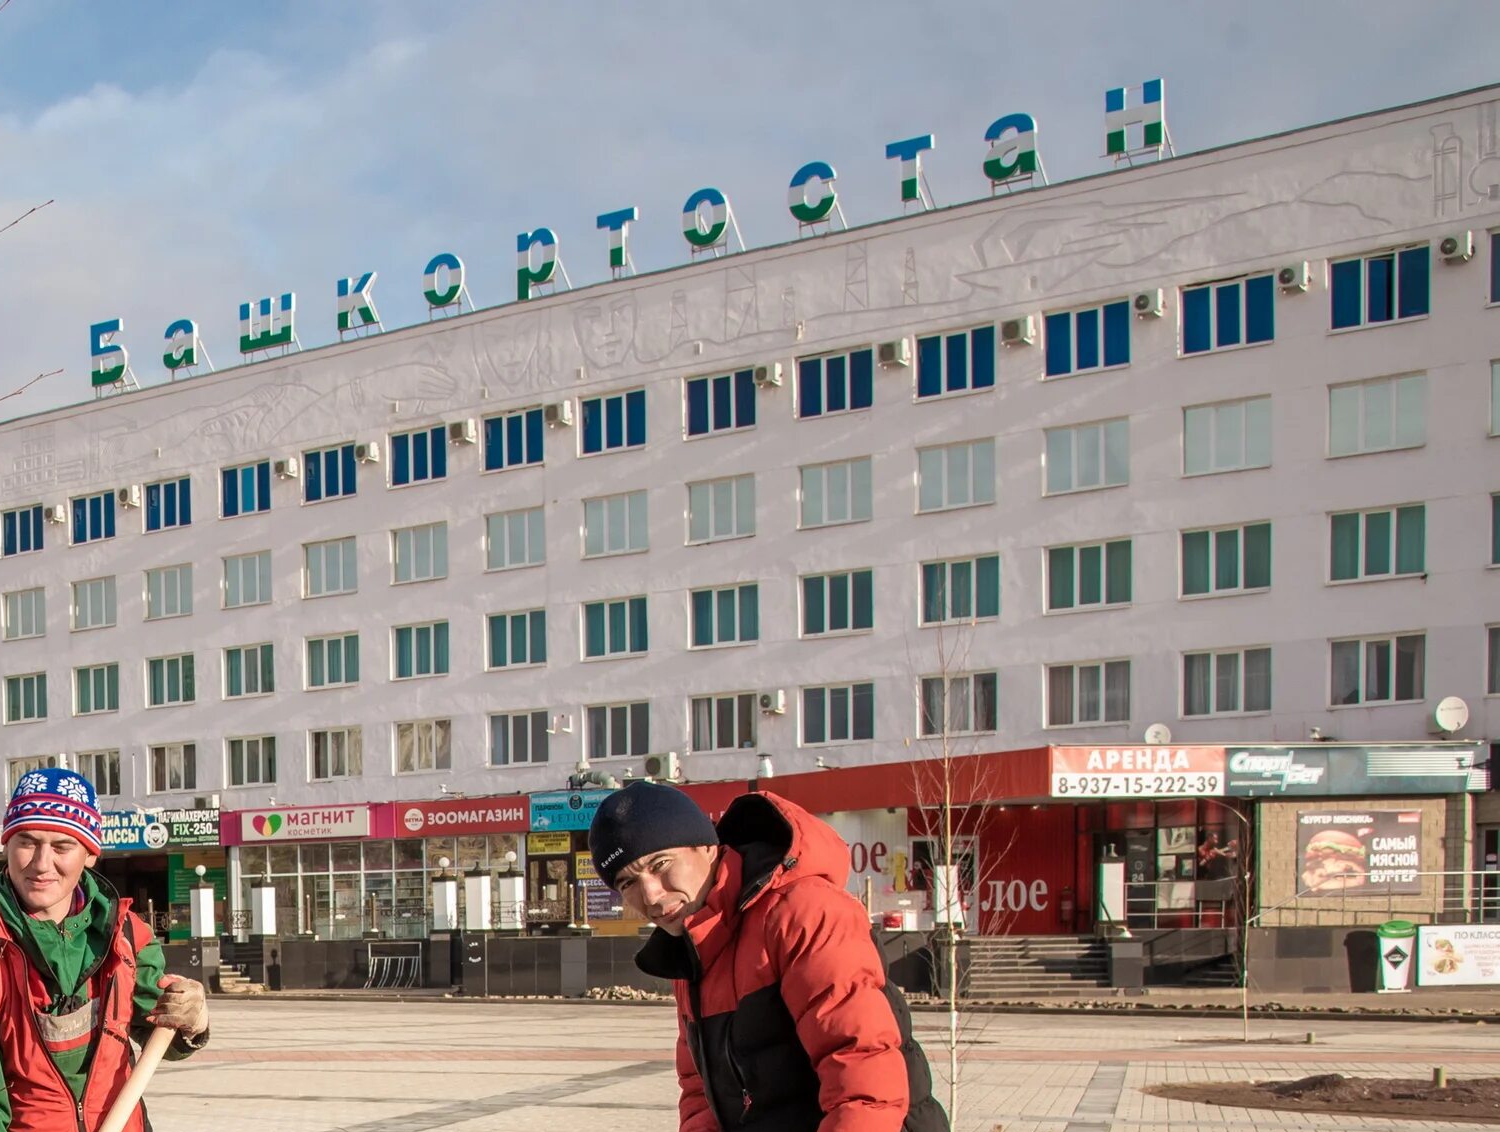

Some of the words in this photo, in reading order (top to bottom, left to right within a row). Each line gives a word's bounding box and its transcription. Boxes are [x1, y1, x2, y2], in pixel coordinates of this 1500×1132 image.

[1086, 749, 1191, 772] АРЕНДА
[1057, 775, 1218, 794] 8-937-15-222-39
[101, 814, 121, 828] ВИА
[130, 813, 147, 827] ЖД
[427, 807, 524, 825] ЗООМАГАЗИН
[173, 822, 213, 836] FIX-250
[287, 827, 332, 837] косметик
[1372, 835, 1417, 851] САМЫЙ
[1370, 852, 1419, 867] МЯСНОЙ
[1131, 873, 1145, 882] 24
[1370, 869, 1417, 883] БУРГЕР
